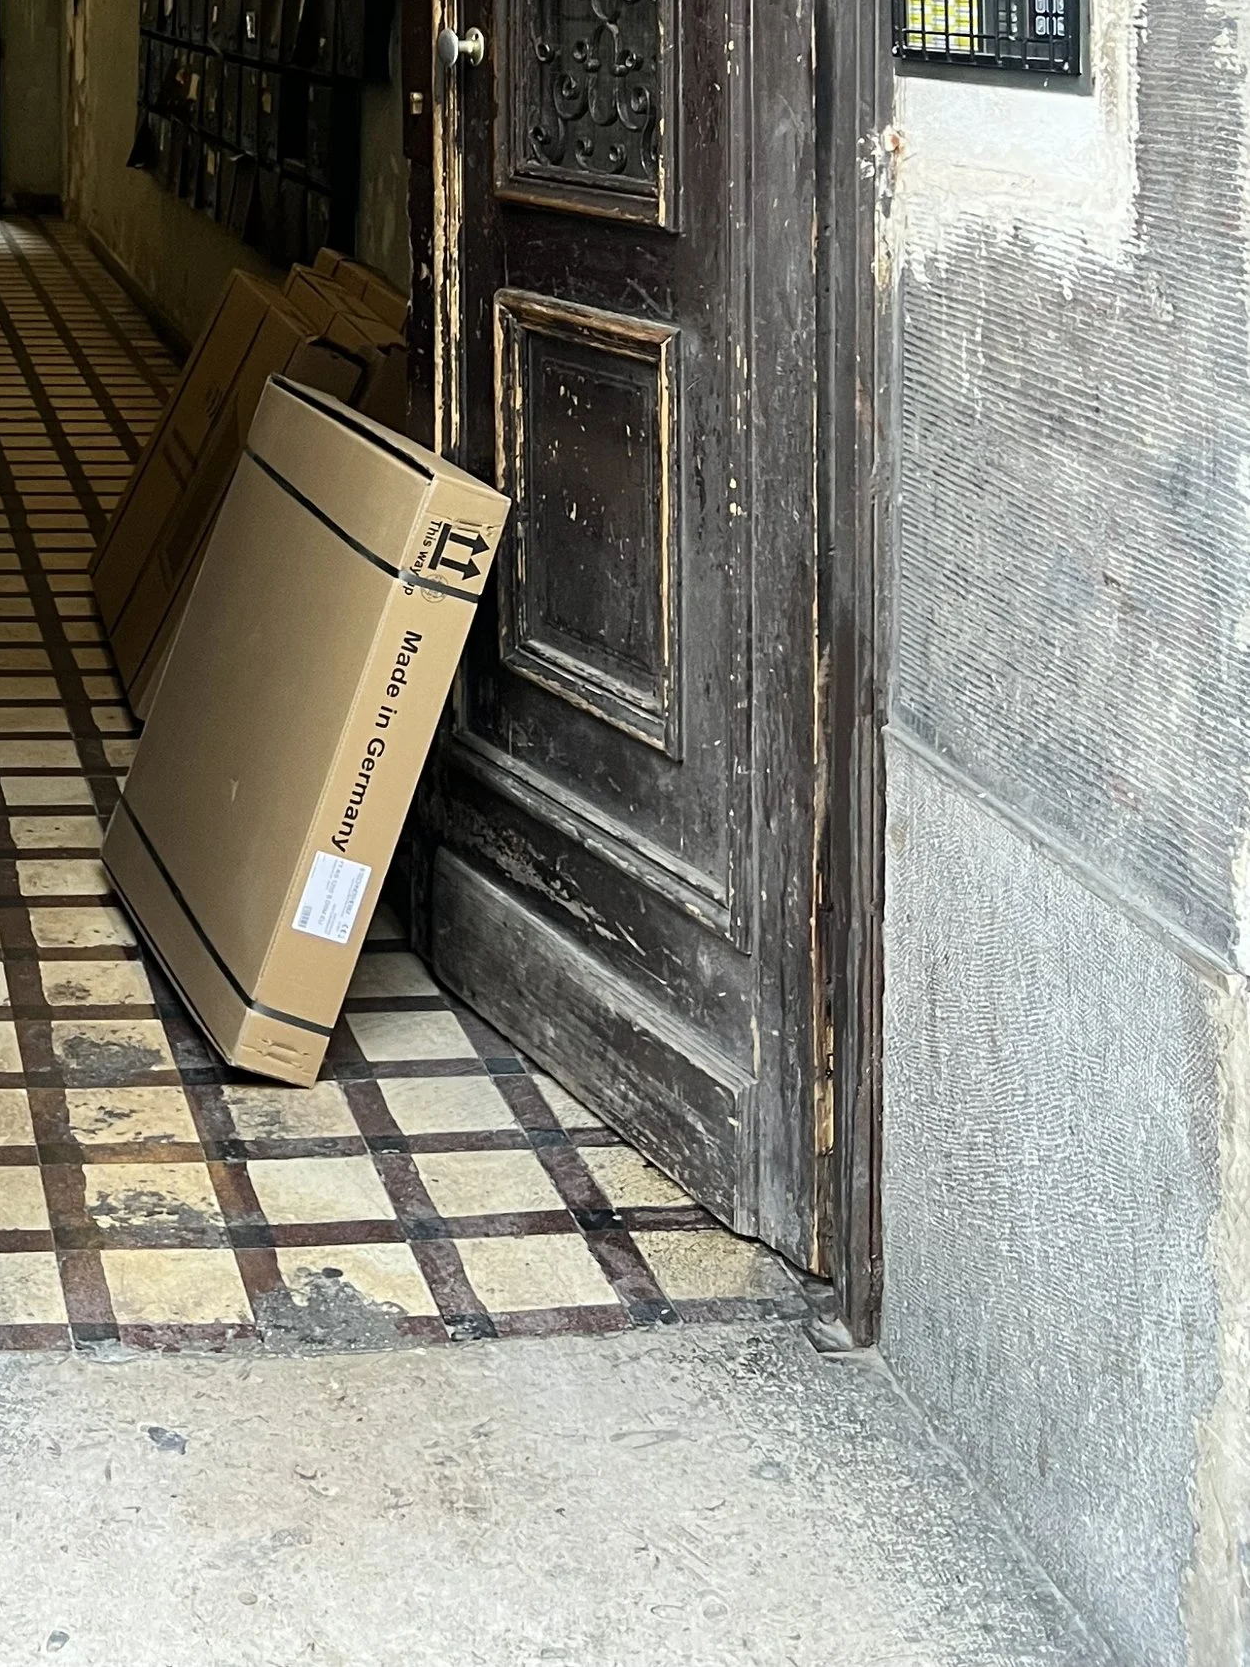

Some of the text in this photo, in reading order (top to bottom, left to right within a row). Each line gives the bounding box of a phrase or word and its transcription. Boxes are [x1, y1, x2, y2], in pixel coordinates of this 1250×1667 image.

[423, 520, 443, 548] This
[410, 551, 428, 577] way
[386, 629, 423, 699] Made
[375, 705, 399, 729] in
[331, 737, 385, 853] Germany
